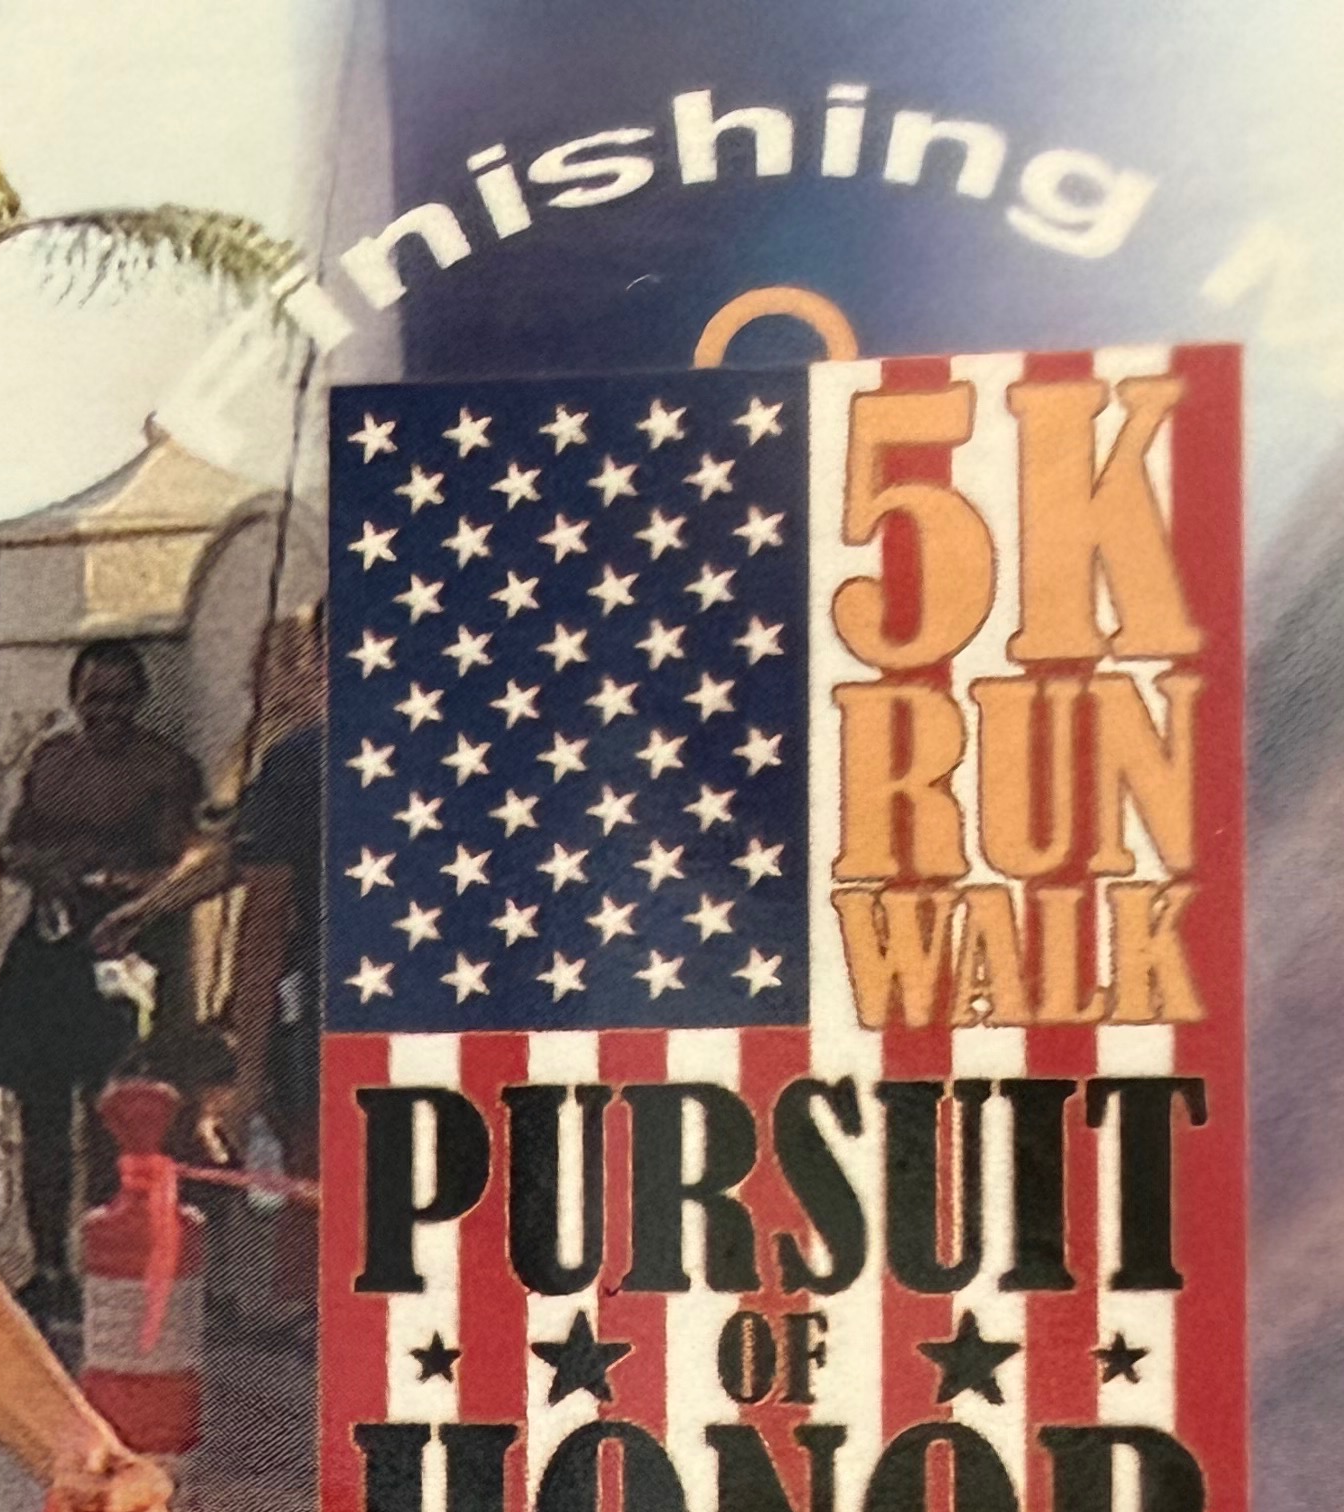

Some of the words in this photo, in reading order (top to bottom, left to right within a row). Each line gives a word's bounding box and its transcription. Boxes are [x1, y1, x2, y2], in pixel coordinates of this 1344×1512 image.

[832, 377, 1204, 669] 5K
[831, 668, 1202, 882] RUN
[830, 880, 1206, 1030] WALK
[353, 1075, 1208, 1297] PURSUIT
[716, 1309, 828, 1405] OF
